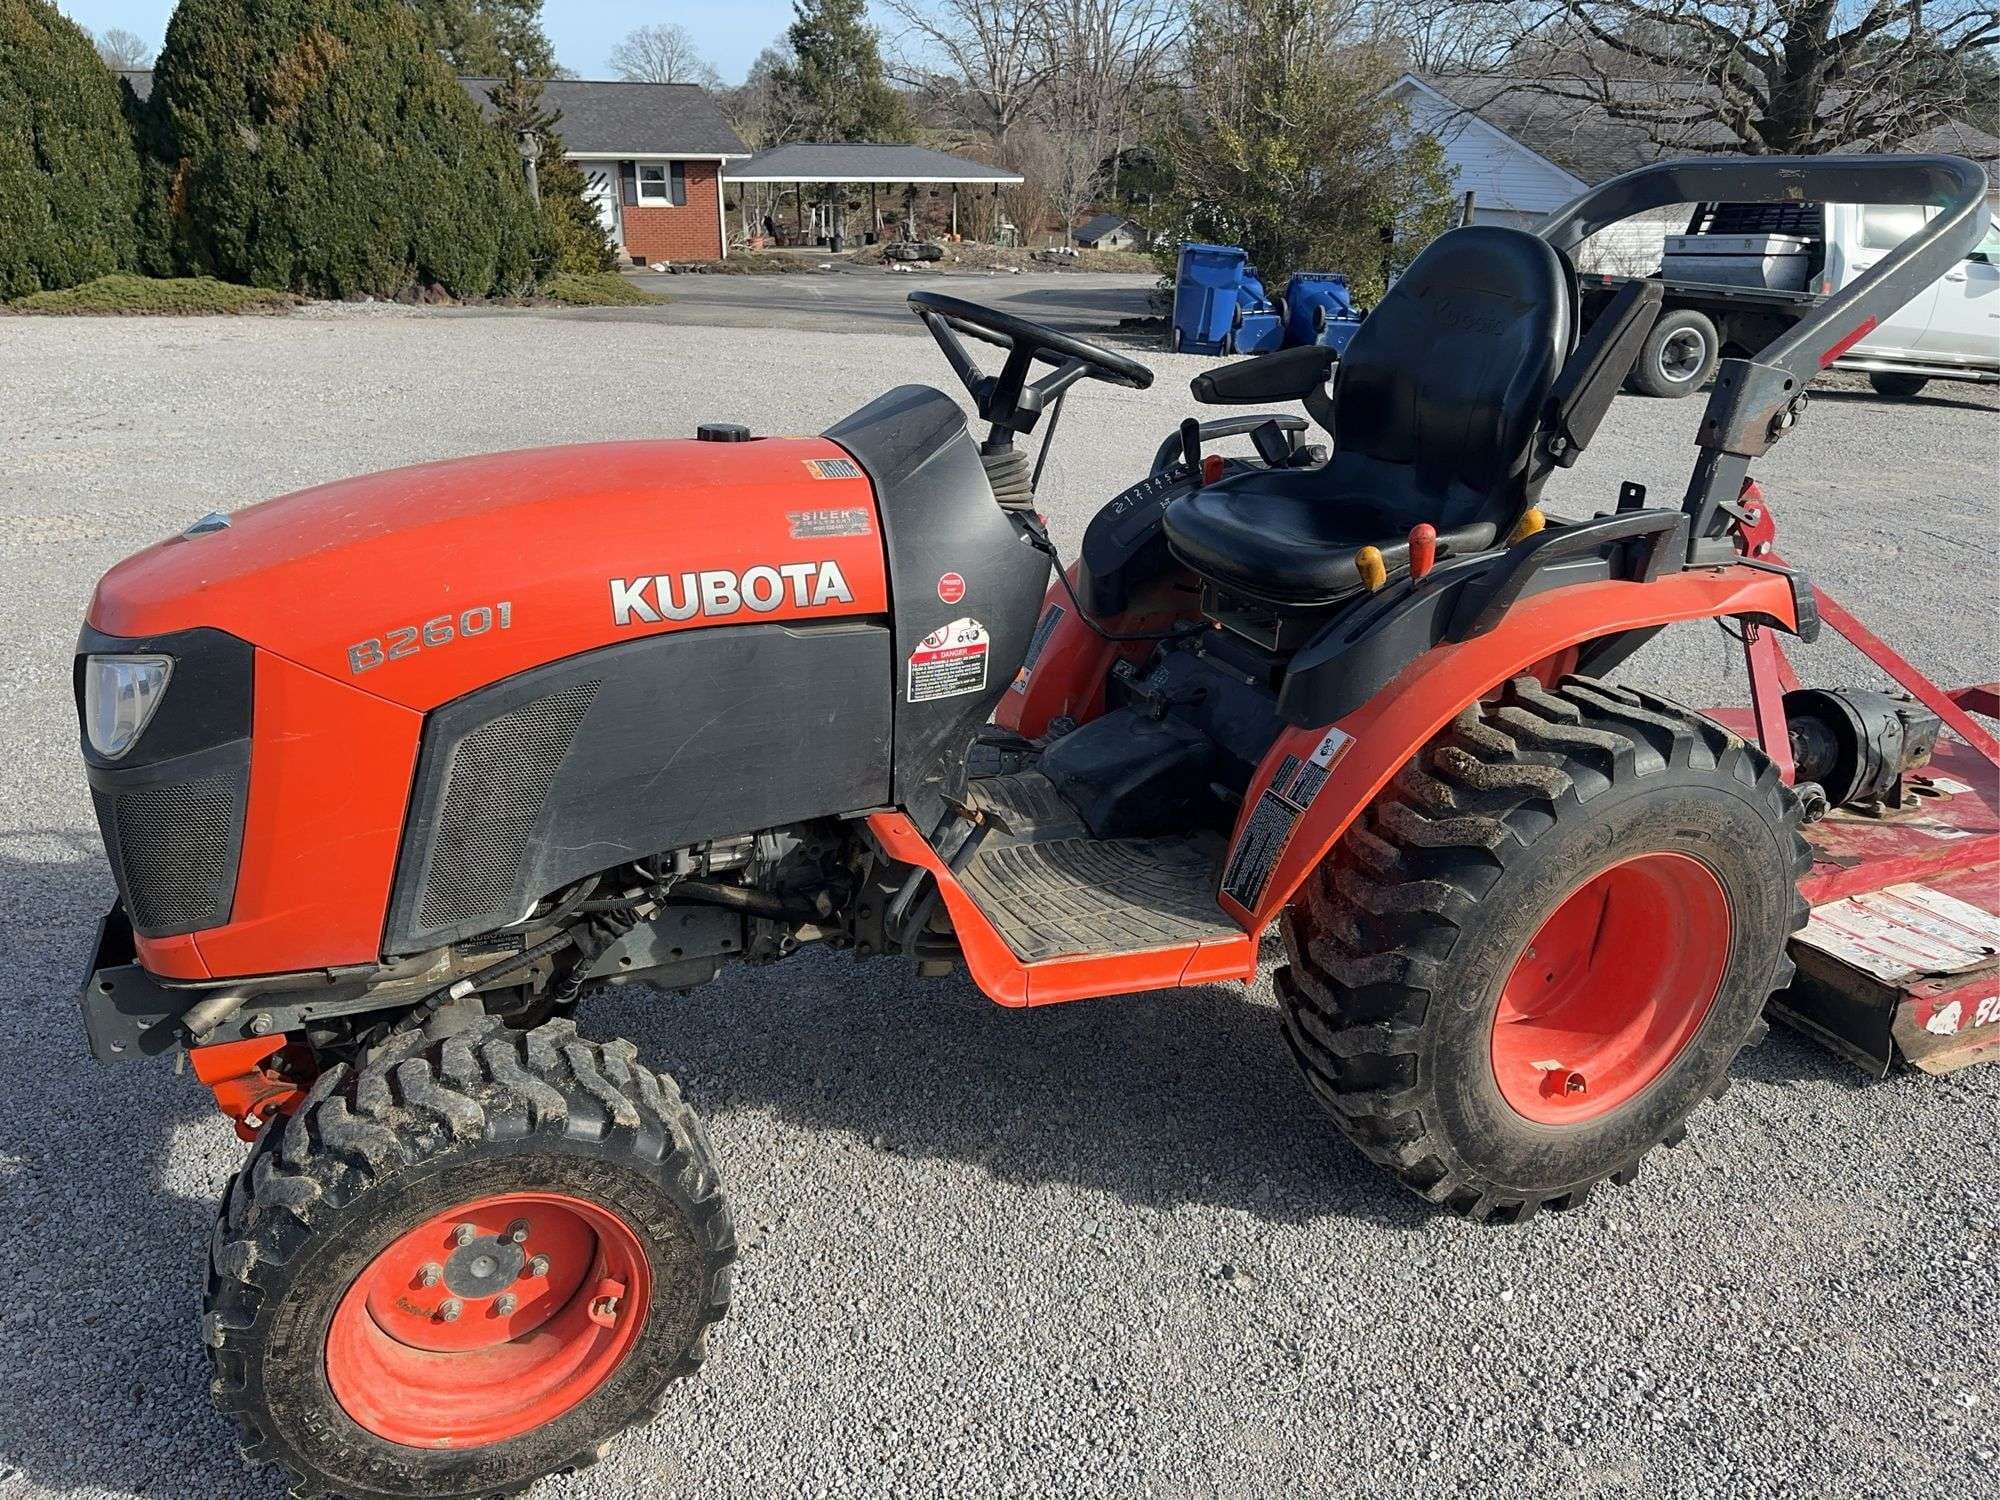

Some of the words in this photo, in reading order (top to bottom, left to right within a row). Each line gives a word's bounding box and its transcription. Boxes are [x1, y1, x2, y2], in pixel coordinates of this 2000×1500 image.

[1133, 488, 1142, 497] 2
[1143, 482, 1151, 491] 3
[1154, 477, 1162, 485] 4
[1164, 473, 1171, 482] 5
[801, 510, 851, 521] SILER
[609, 560, 855, 627] KUBOTA
[348, 601, 513, 675] B2601
[940, 648, 968, 658] DANGER
[469, 933, 510, 942] KUBO
[580, 1173, 676, 1241] TITAN
